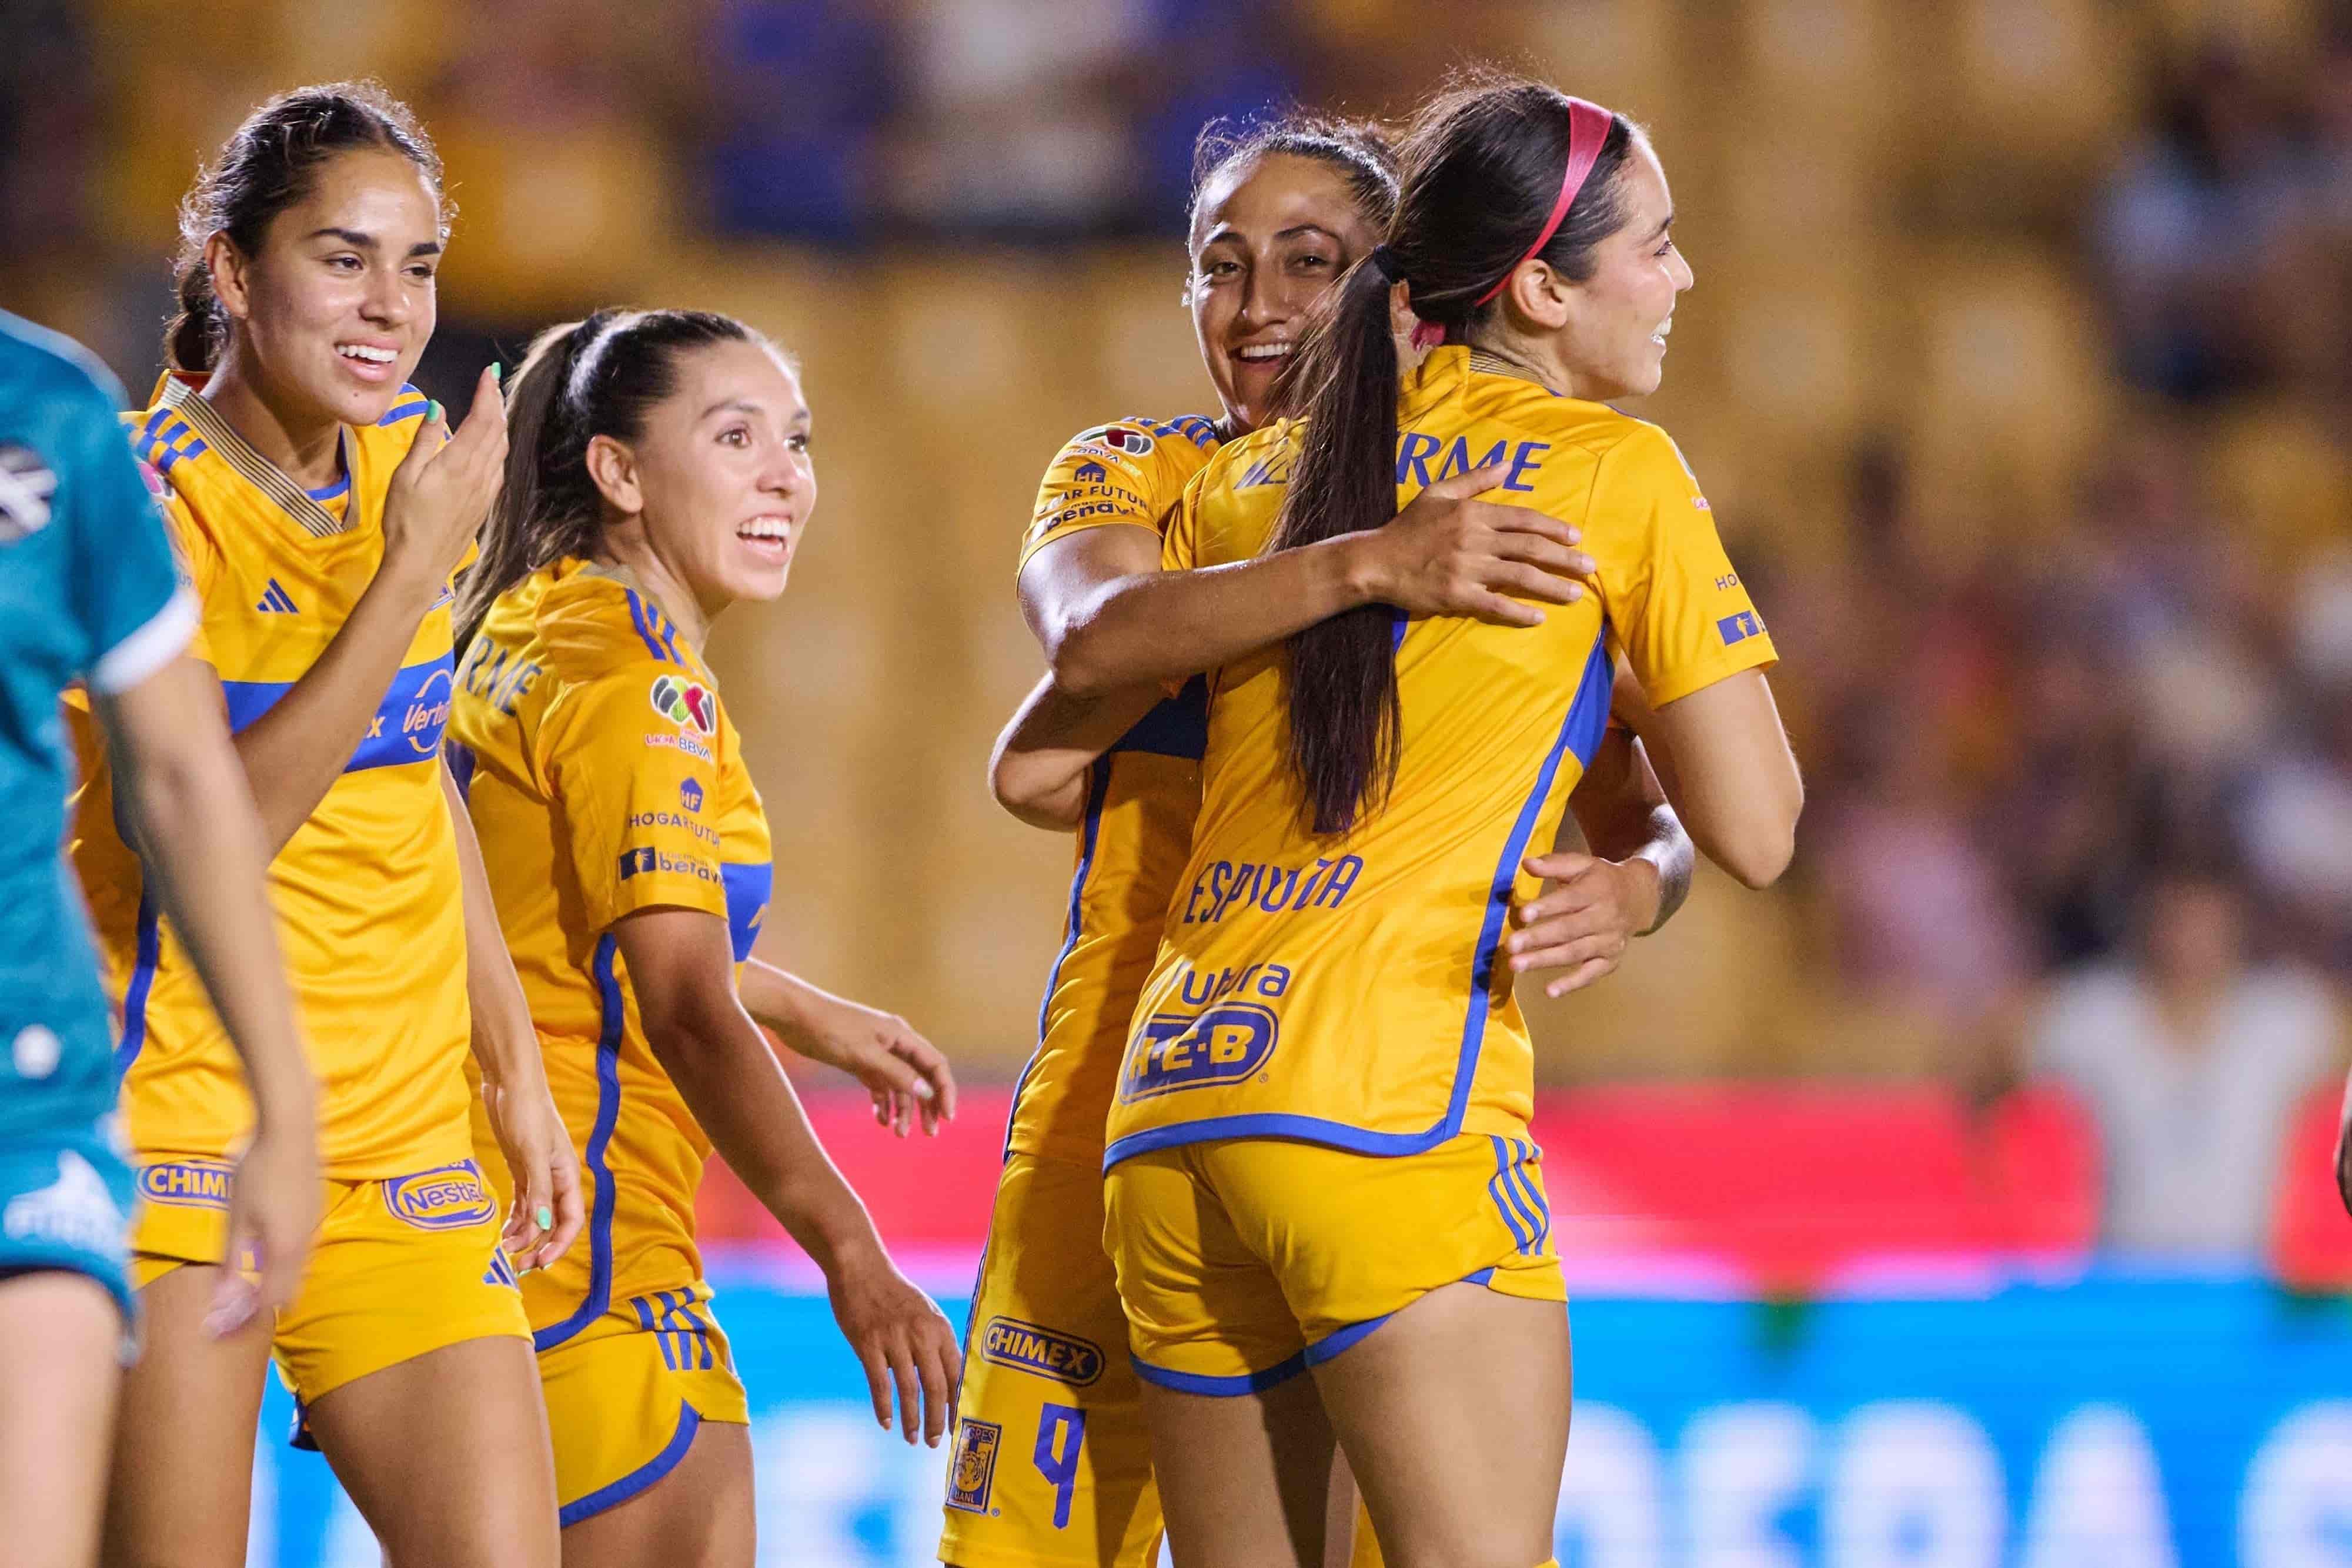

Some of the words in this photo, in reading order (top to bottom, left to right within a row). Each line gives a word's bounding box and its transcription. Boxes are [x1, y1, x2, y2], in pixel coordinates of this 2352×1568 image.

[681, 790, 701, 810] HF
[148, 1167, 232, 1198] CHIM
[987, 1326, 1090, 1375] CHIMEX
[1033, 1402, 1087, 1529] 9
[954, 1490, 974, 1504] UANL
